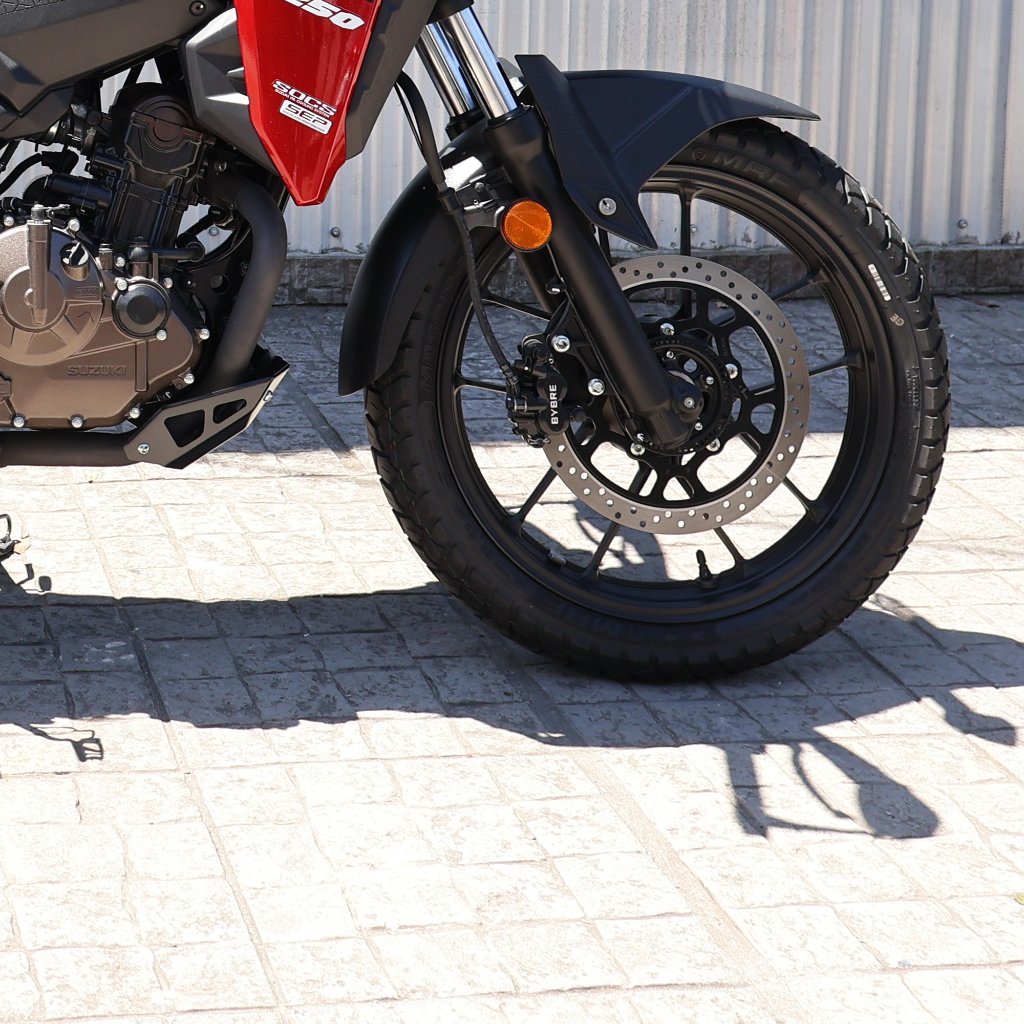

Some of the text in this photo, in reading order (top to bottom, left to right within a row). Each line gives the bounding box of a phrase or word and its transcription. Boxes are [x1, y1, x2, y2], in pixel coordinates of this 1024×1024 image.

[273, 80, 337, 116] SOCS
[284, 104, 328, 126] SEP
[66, 364, 127, 377] SUZUKI
[549, 384, 559, 425] BYBRE
